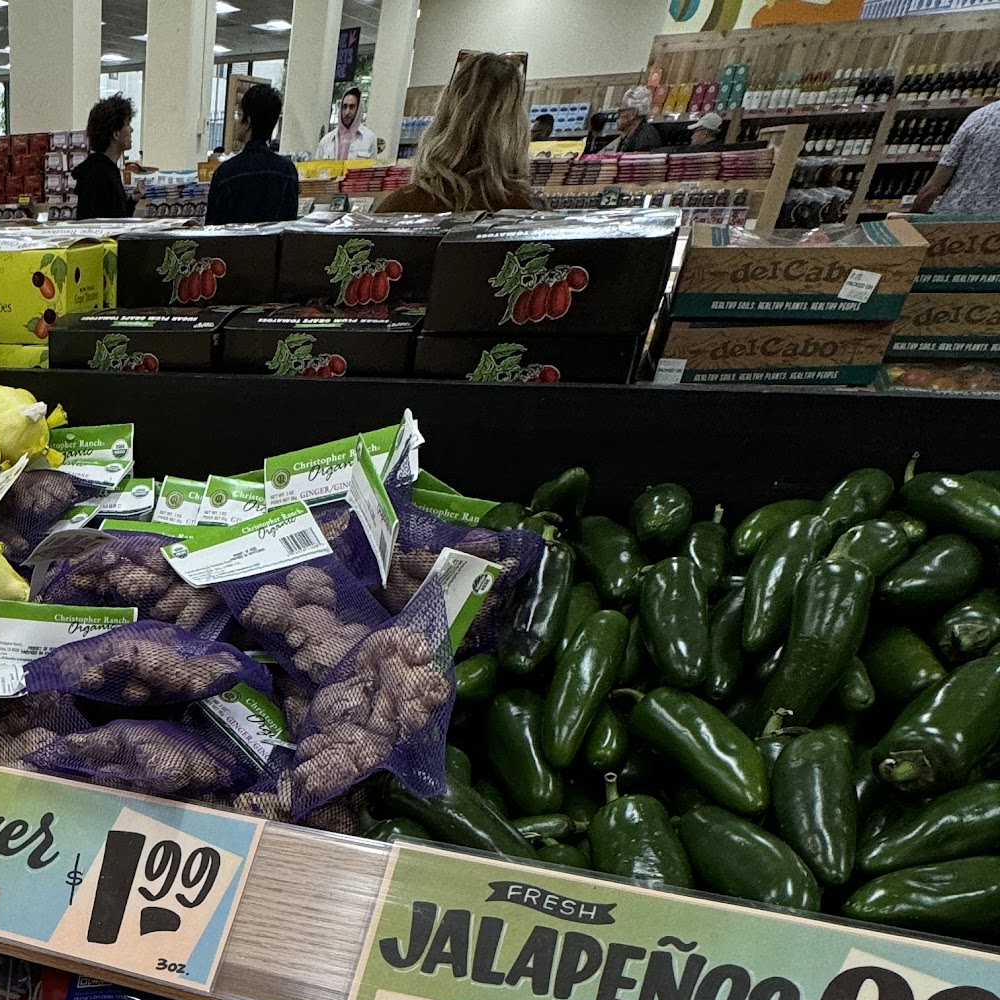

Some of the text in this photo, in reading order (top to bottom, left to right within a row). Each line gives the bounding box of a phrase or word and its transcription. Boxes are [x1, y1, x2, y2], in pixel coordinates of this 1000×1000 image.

[79, 439, 102, 448] Ranch
[294, 450, 346, 471] Christopher
[241, 508, 302, 534] Christopher Ranch
[54, 614, 127, 624] Christopher Ranch
[507, 884, 597, 921] FRESH
